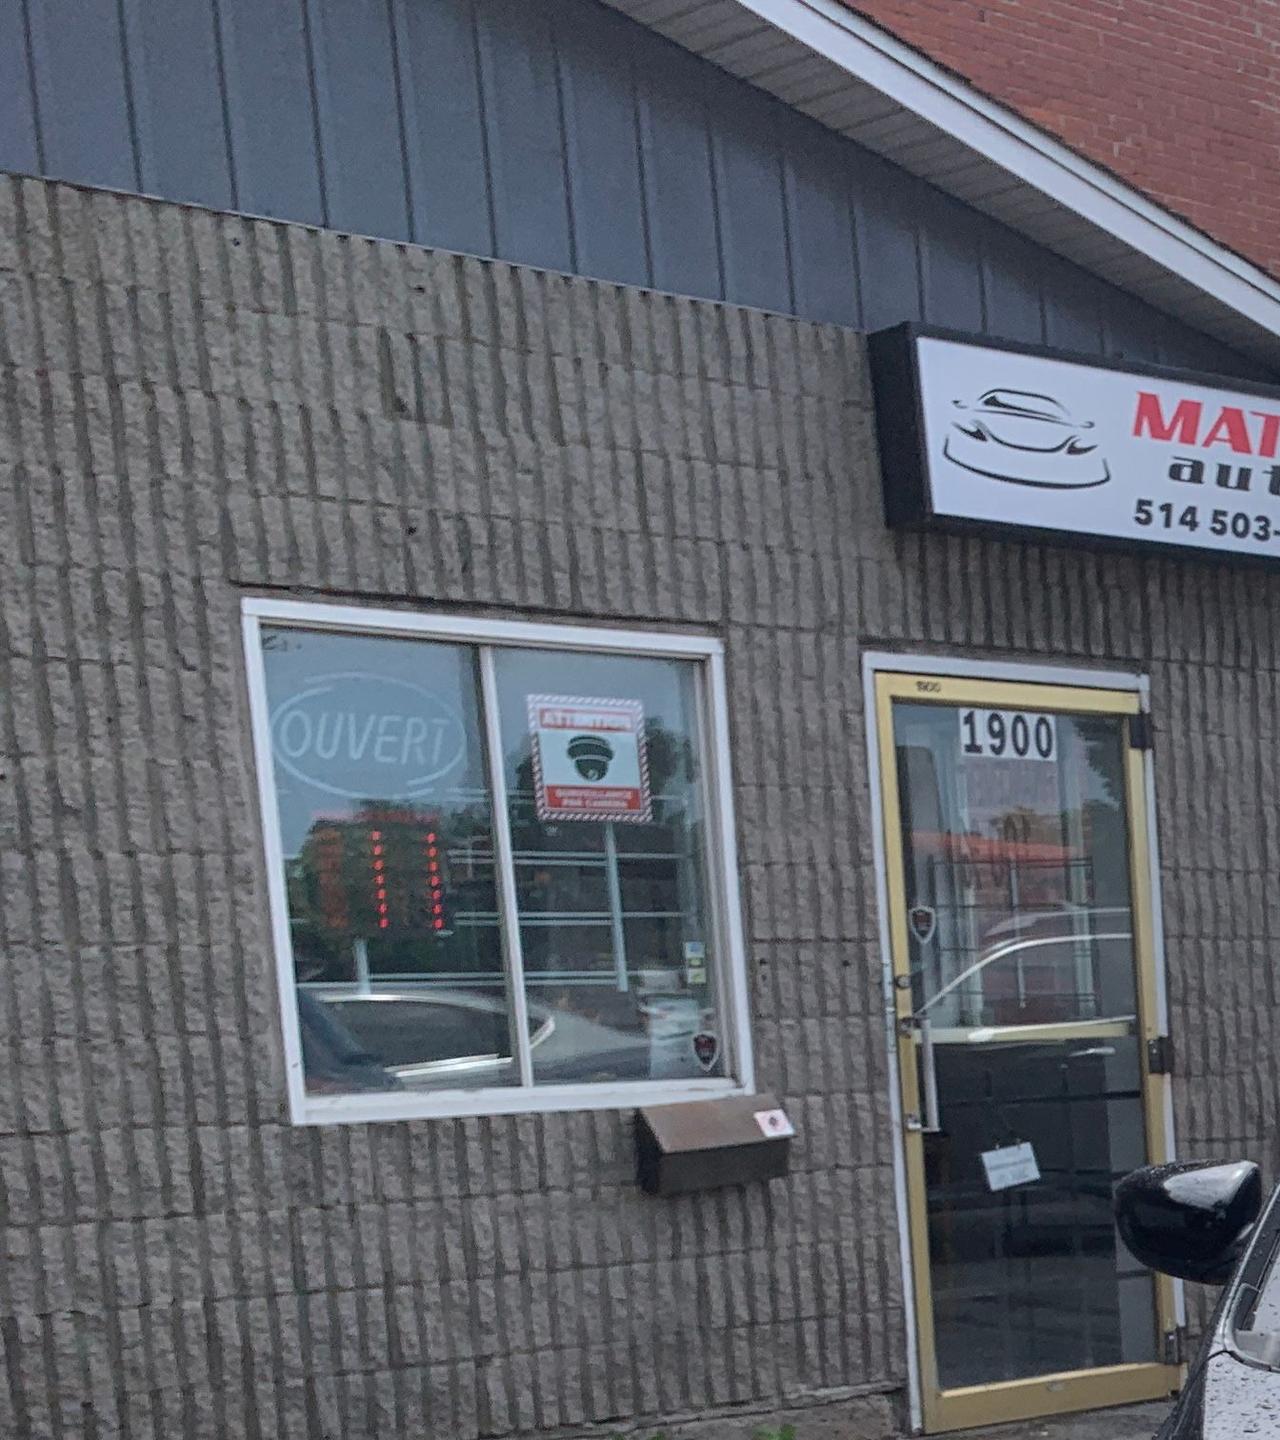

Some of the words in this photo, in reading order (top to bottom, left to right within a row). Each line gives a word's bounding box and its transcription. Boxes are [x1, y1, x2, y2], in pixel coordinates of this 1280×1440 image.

[1134, 498, 1200, 533] 514
[278, 709, 449, 767] OUVERT
[962, 710, 1053, 759] 1900
